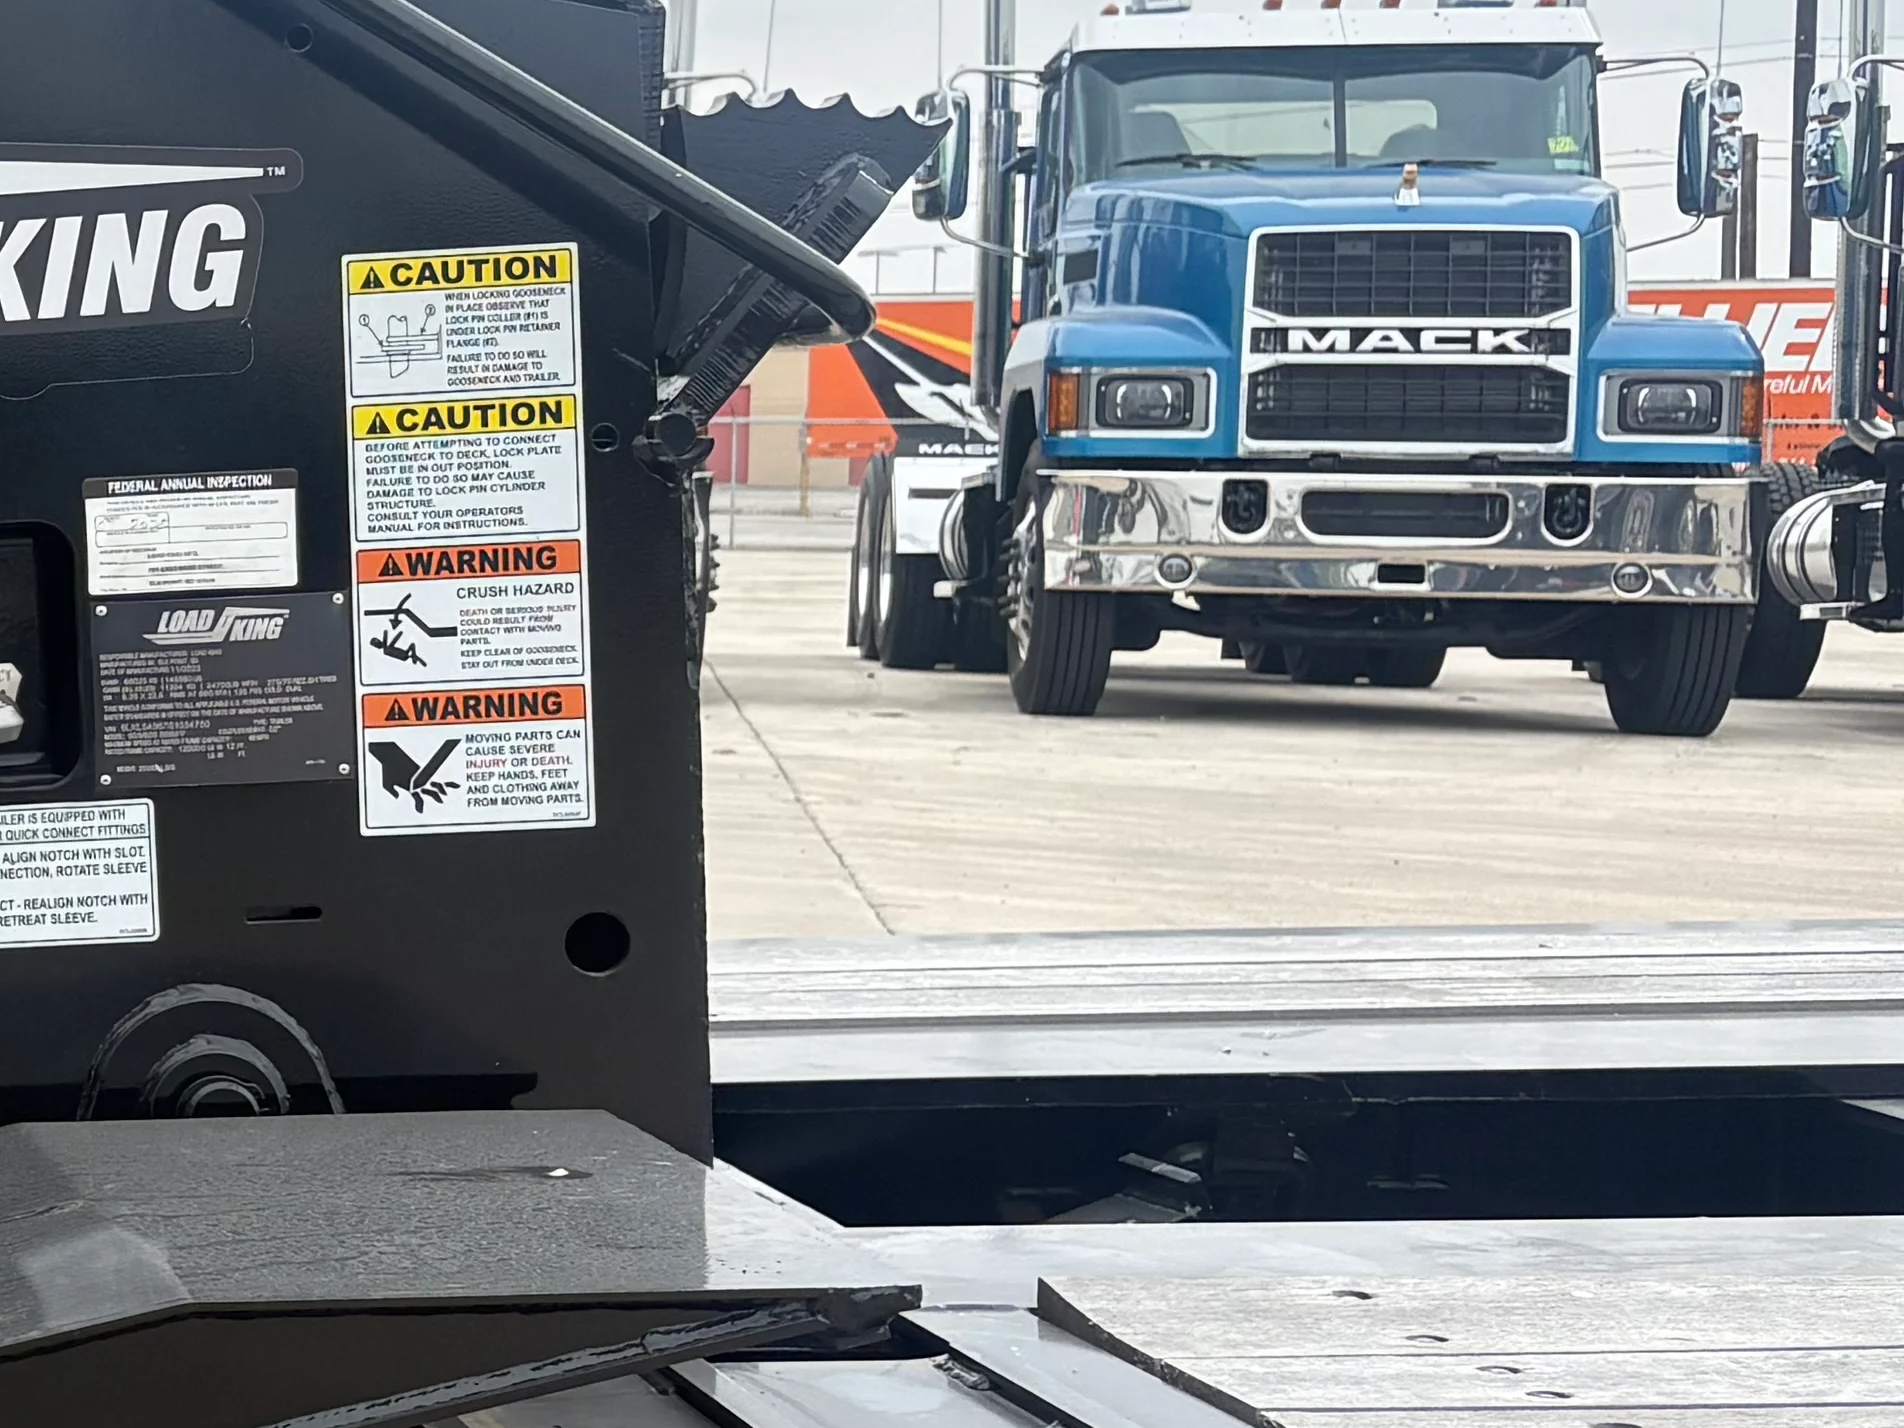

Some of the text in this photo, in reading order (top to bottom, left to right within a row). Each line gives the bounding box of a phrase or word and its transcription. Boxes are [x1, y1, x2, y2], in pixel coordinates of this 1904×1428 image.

[390, 255, 557, 286] CAUTION
[1288, 328, 1531, 353] MACK
[1764, 377, 1810, 394] reful
[396, 400, 563, 432] CAUTION
[365, 434, 556, 452] BEFORE ATTEMPTING TO CONNECT
[365, 452, 436, 464] GOOSENECK
[440, 450, 453, 460] TO
[493, 448, 523, 458] LOCK
[527, 445, 562, 456] PLATE
[366, 465, 396, 475] MUST
[400, 464, 414, 474] BE
[418, 463, 429, 473] IN
[431, 462, 454, 472] OUT
[108, 474, 272, 494] FEDERAL ANNUAL INSPECTION
[368, 506, 523, 522] CONSULT YOUR OPERATORS
[368, 522, 413, 533] MANUAL
[418, 521, 440, 531] FOR
[405, 545, 556, 576] WARNING
[456, 583, 574, 600] CRUSH HAZARD
[157, 609, 284, 641] LOAD KING
[412, 691, 562, 722] WARNING
[465, 729, 581, 744] MOVING PARTS CAN
[466, 743, 556, 756] CAUSE SEVERE
[466, 757, 507, 770] INJURY
[511, 756, 528, 767] OR
[467, 770, 495, 782] KEEP
[541, 768, 568, 779] FEET
[467, 779, 579, 795] AND CLOTHING AWAY
[467, 795, 498, 808] FROM
[501, 793, 544, 806] MOVING
[28, 814, 37, 824] IS
[42, 811, 95, 823] EQUIPPED
[98, 809, 125, 820] WITH
[6, 829, 39, 840] QUICK
[43, 826, 93, 838] CONNECT
[98, 824, 146, 836] FITTINGS
[3, 852, 36, 865] ALIGN
[40, 850, 79, 862] NOTCH
[83, 848, 111, 860] WITH
[57, 865, 99, 876] ROTATE
[104, 862, 147, 874] SLEEVE
[24, 898, 73, 910] REALIGN
[77, 896, 116, 907] NOTCH
[120, 894, 148, 905] WITH
[51, 912, 97, 924] SLEEVE.
